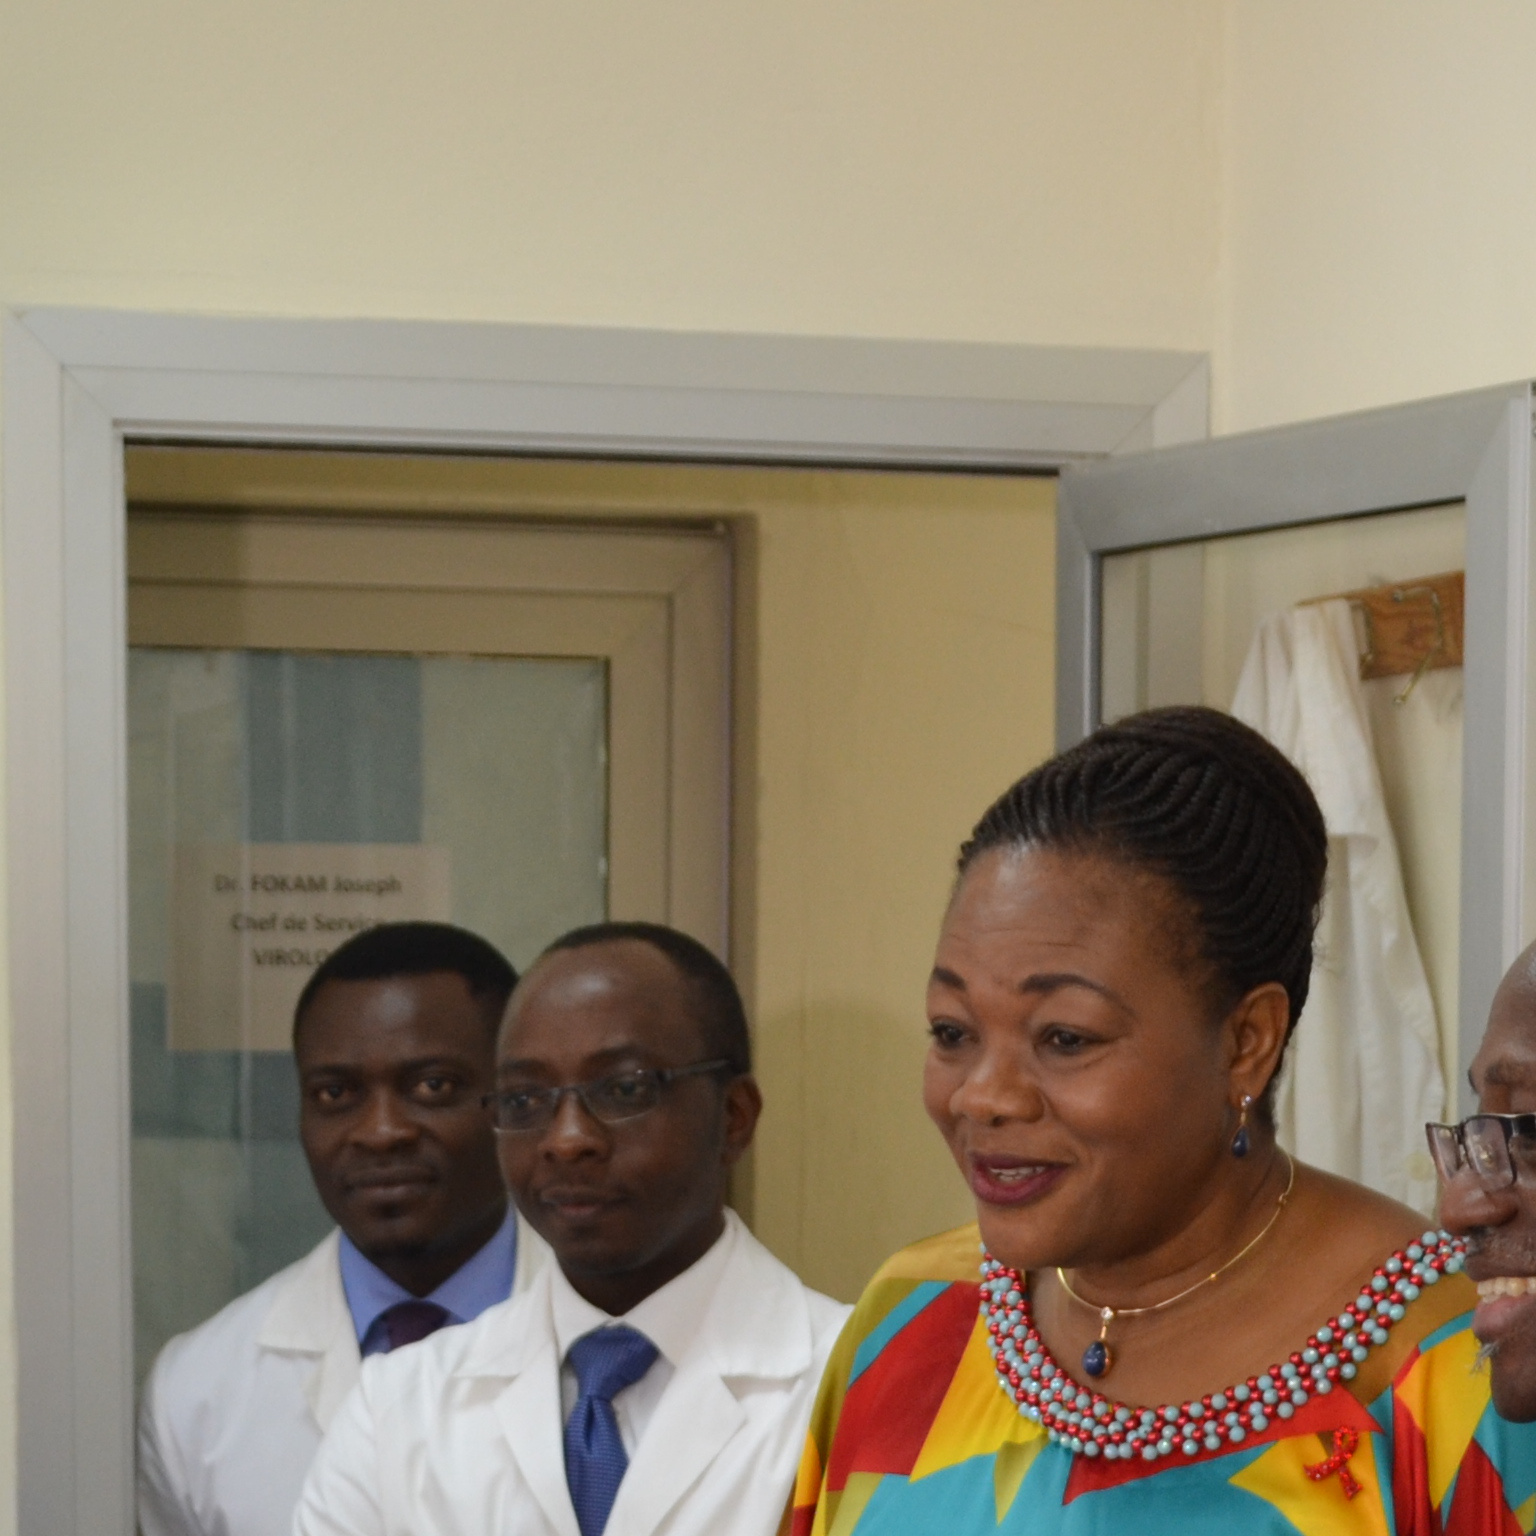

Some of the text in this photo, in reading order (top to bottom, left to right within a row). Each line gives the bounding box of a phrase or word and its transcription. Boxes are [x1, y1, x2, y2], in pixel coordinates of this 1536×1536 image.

[250, 874, 328, 893] FOKAM
[333, 873, 403, 896] Joseph
[229, 911, 386, 932] Chef de Servic
[251, 947, 332, 966] VIROLO
